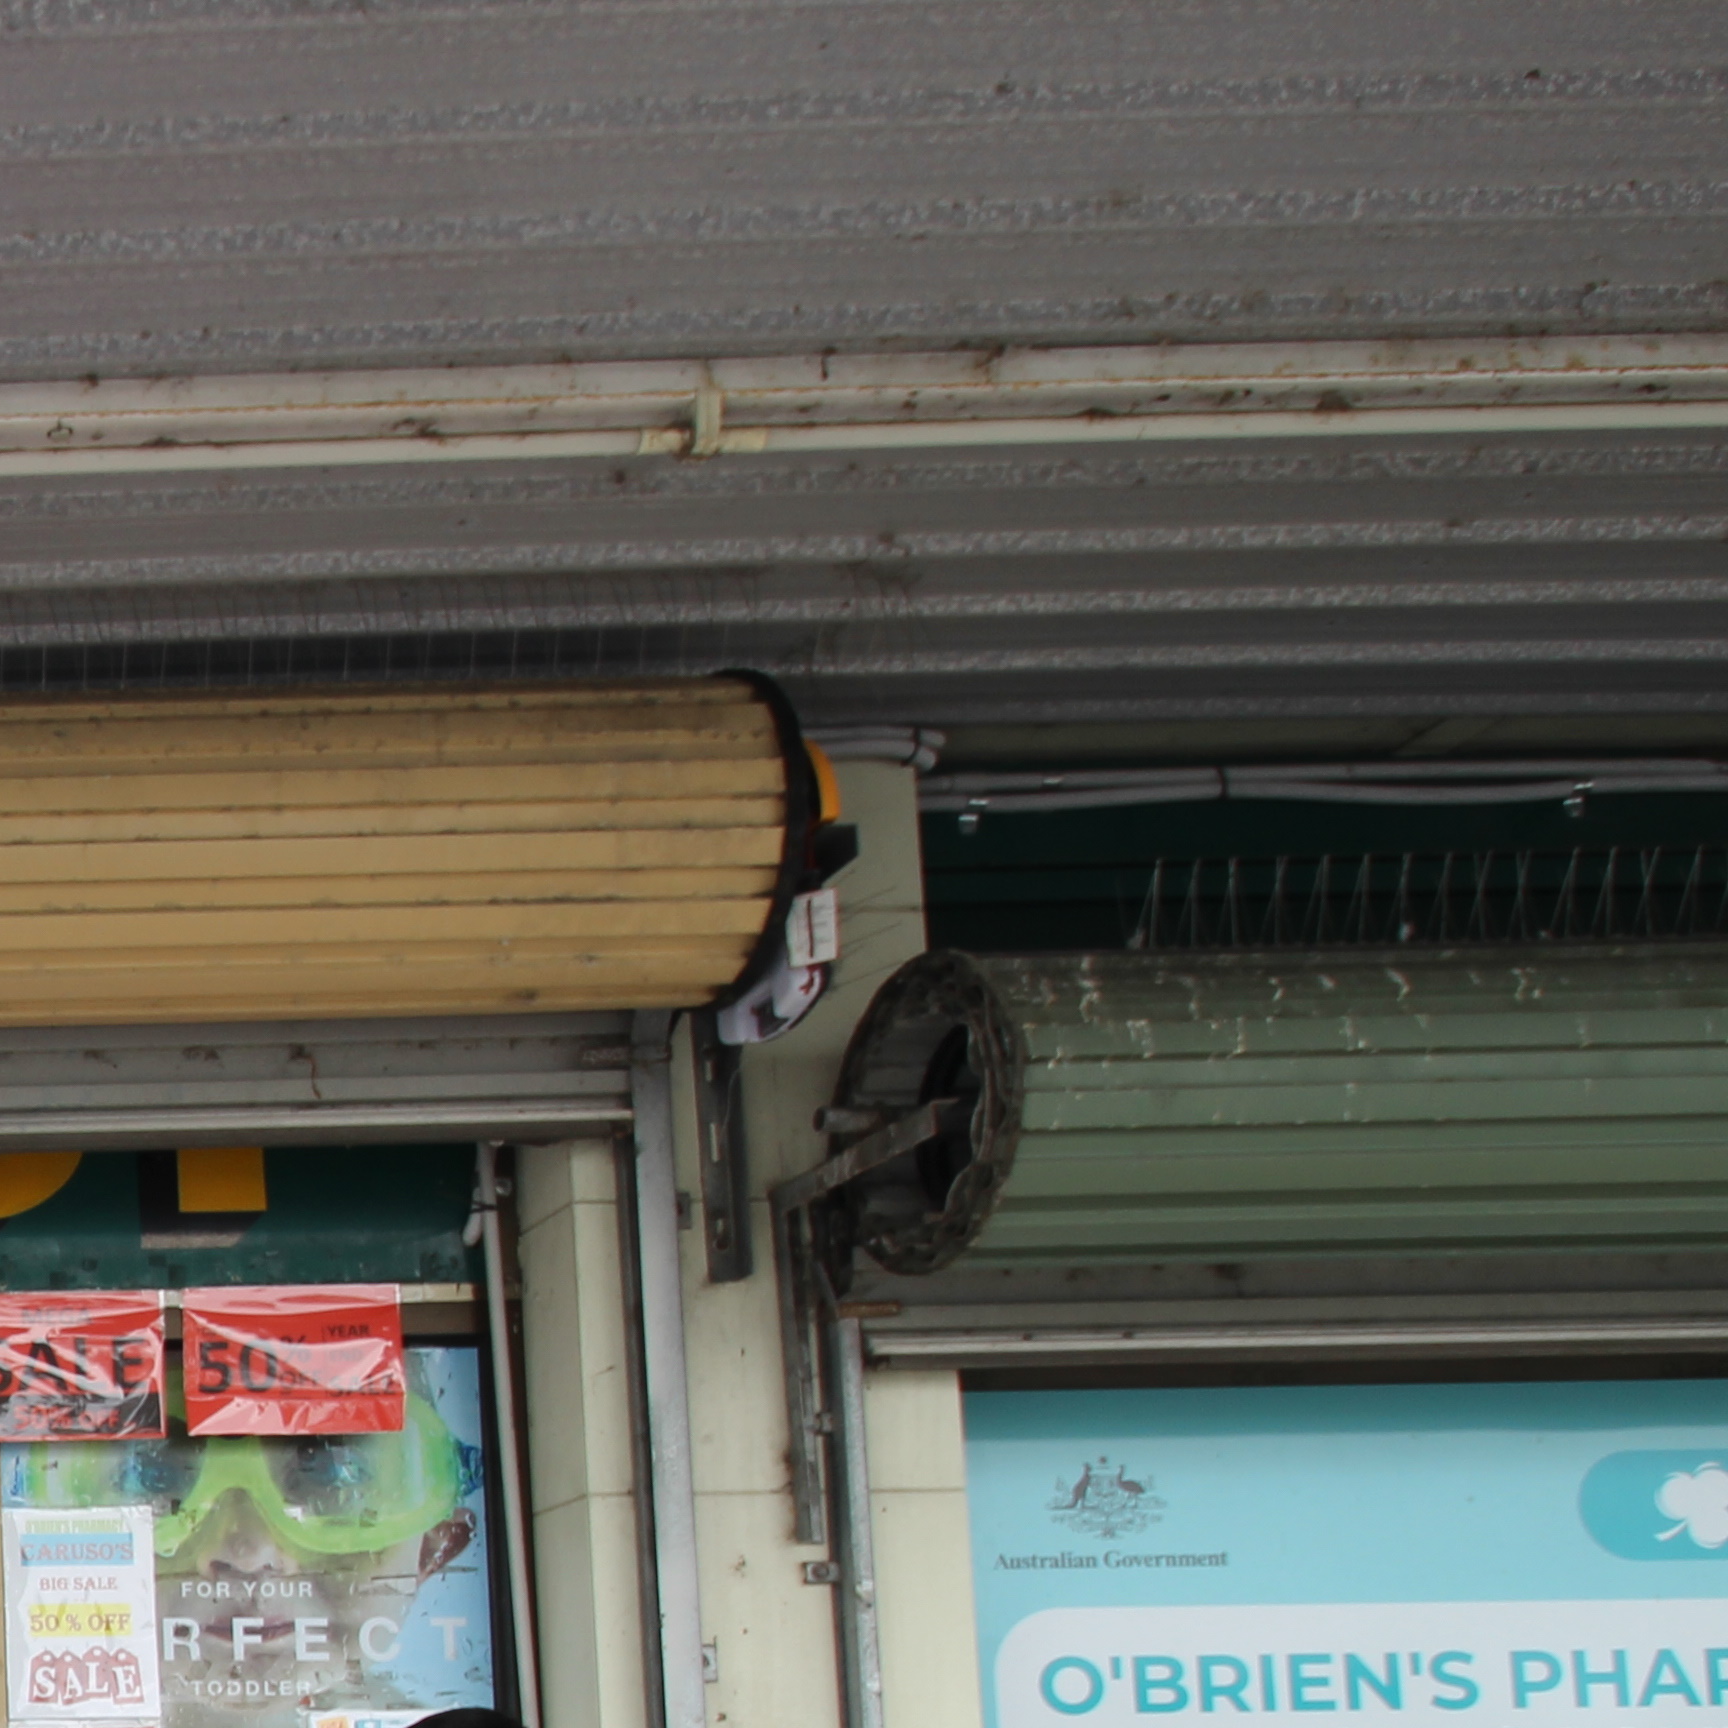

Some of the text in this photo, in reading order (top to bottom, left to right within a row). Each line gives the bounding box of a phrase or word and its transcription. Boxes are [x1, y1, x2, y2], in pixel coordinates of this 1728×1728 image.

[326, 1324, 370, 1339] YEAR
[24, 1543, 133, 1561] CARUSO'S
[994, 1548, 1229, 1571] Australian Government
[39, 1577, 117, 1590] BIG SALE
[181, 1581, 313, 1597] FOR YOUR
[30, 1613, 131, 1632] 50 OFF
[32, 1660, 141, 1700] SALE
[192, 1679, 314, 1697] TODDLER
[1039, 1650, 1481, 1716] O'BRIEN'S
